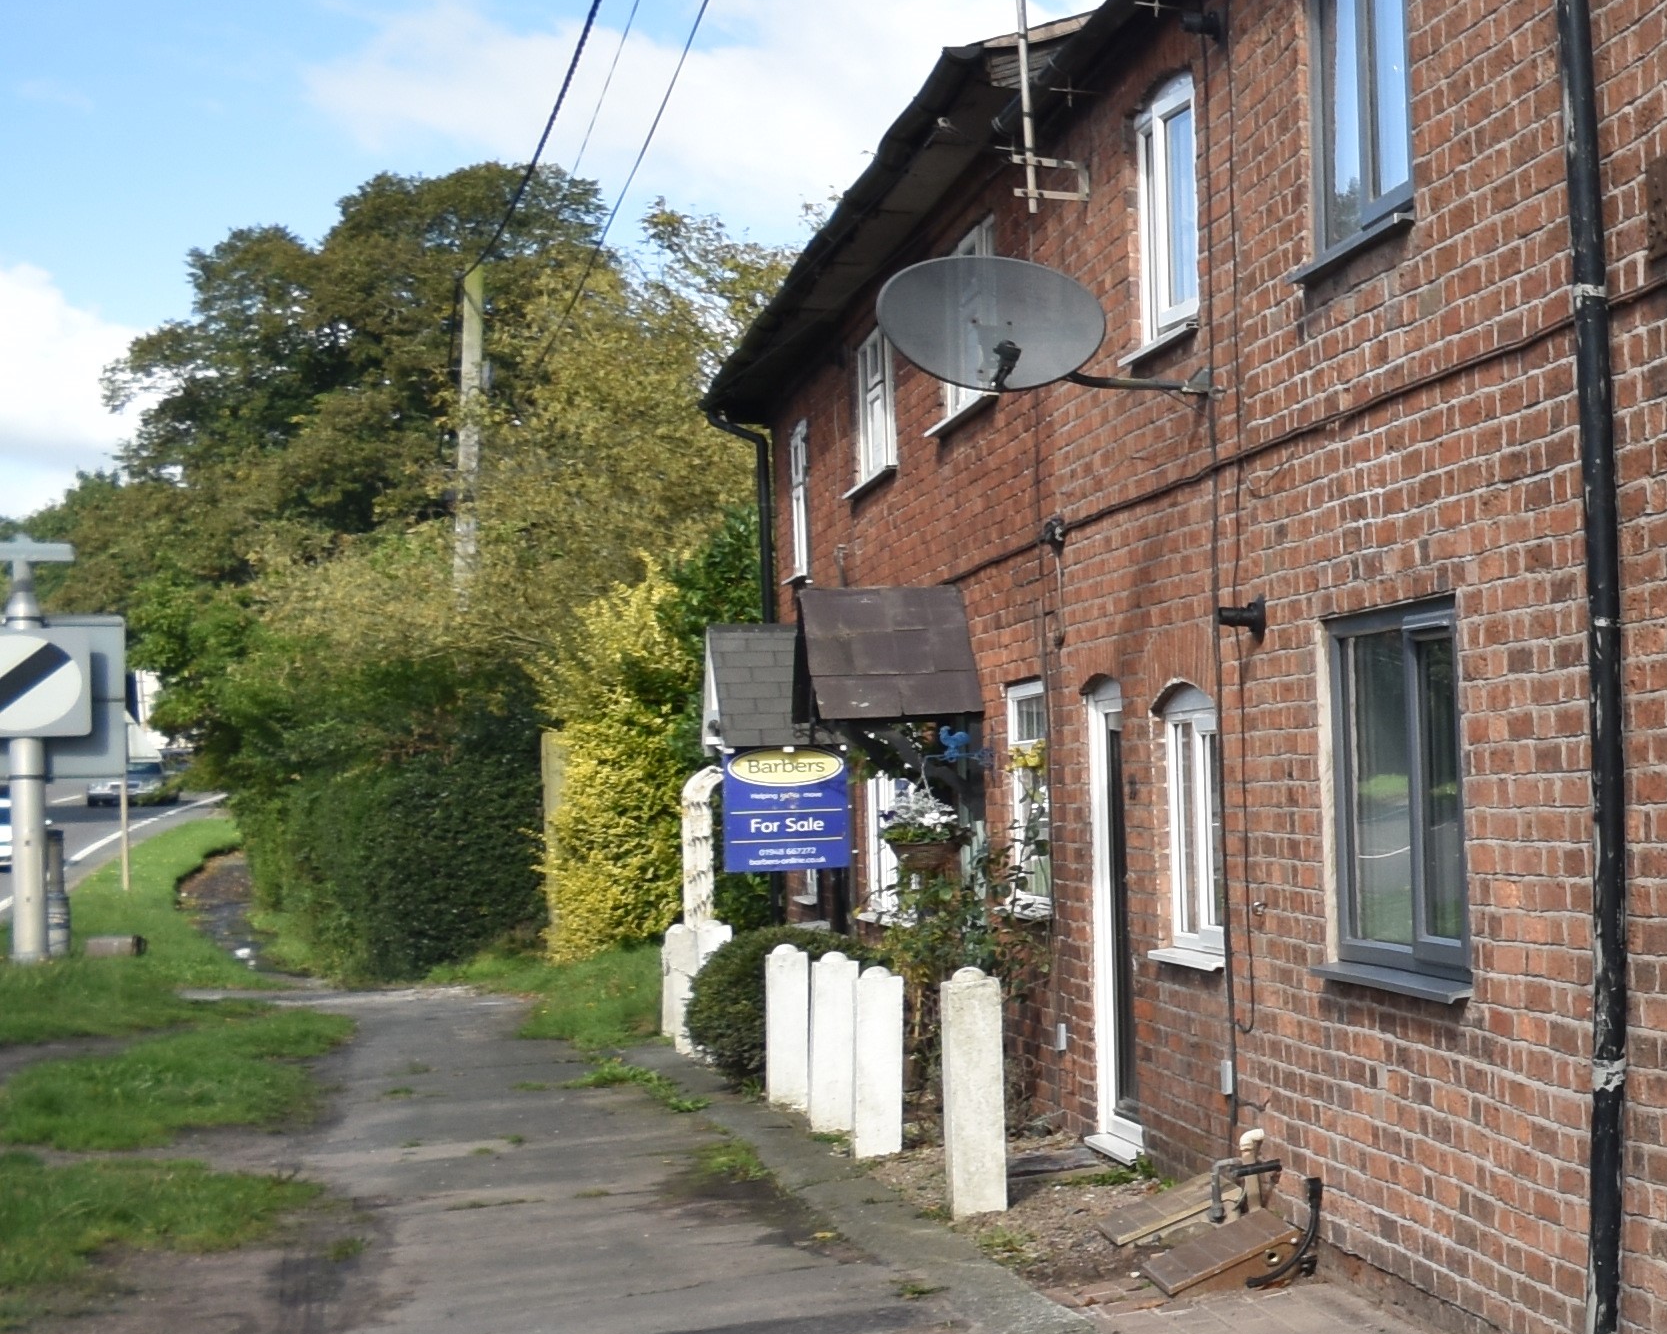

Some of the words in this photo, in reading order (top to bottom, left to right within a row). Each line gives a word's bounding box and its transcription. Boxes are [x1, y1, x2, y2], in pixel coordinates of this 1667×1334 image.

[747, 758, 825, 773] Barbers
[750, 818, 780, 833] For
[785, 817, 825, 832] Sale
